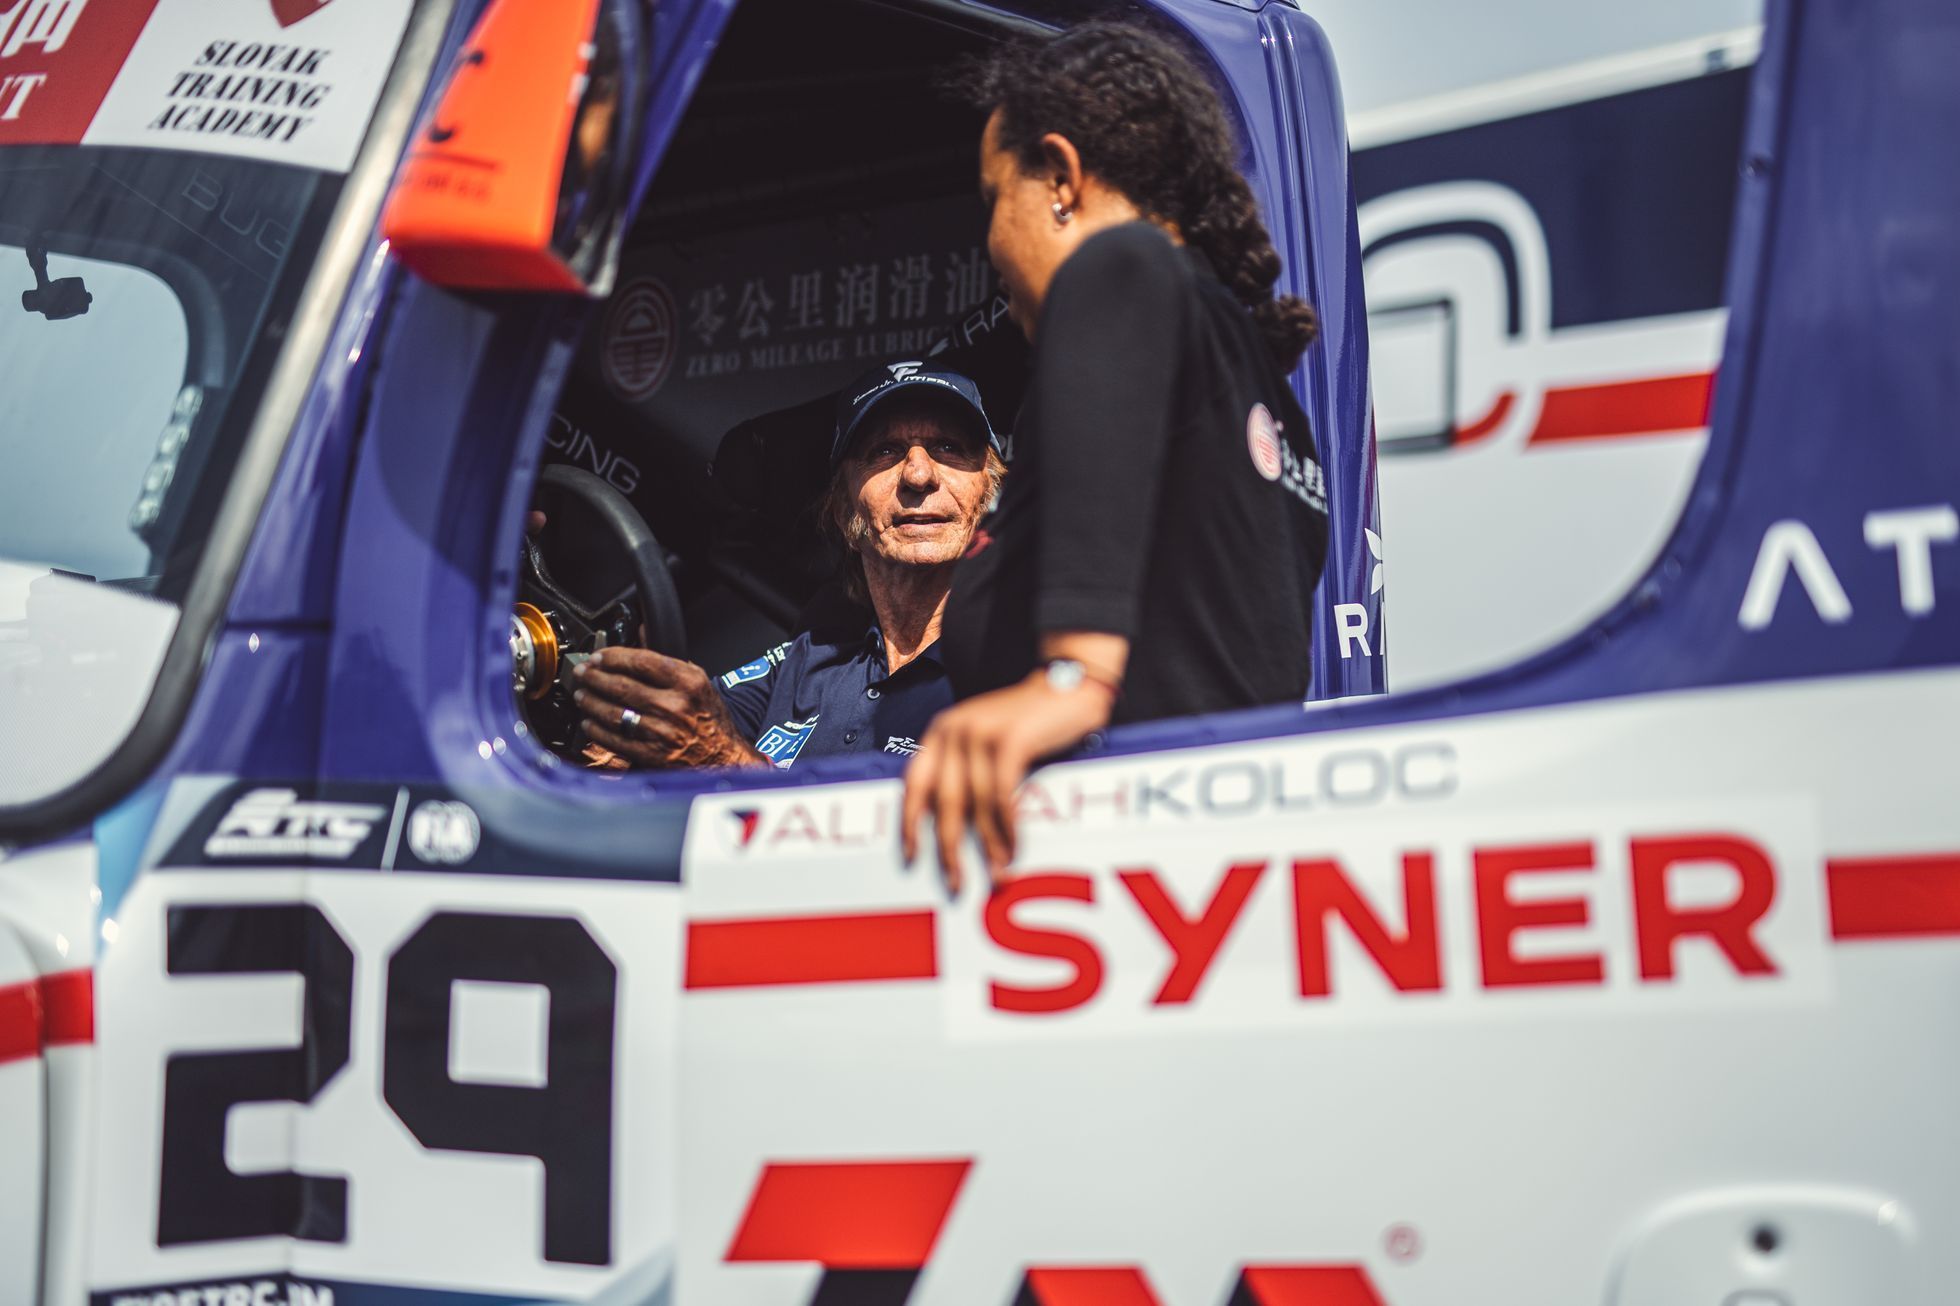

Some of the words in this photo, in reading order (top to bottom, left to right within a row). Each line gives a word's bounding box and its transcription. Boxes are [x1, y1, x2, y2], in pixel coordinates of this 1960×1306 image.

[195, 40, 332, 75] SLOVAK
[166, 72, 332, 110] TRAINING
[148, 104, 312, 143] ACADEMY
[687, 247, 992, 346] 零公里润滑油
[685, 350, 741, 378] ZERO
[750, 339, 842, 371] MILEAGE
[984, 831, 1783, 1016] SYNER
[157, 902, 618, 1267] 29
